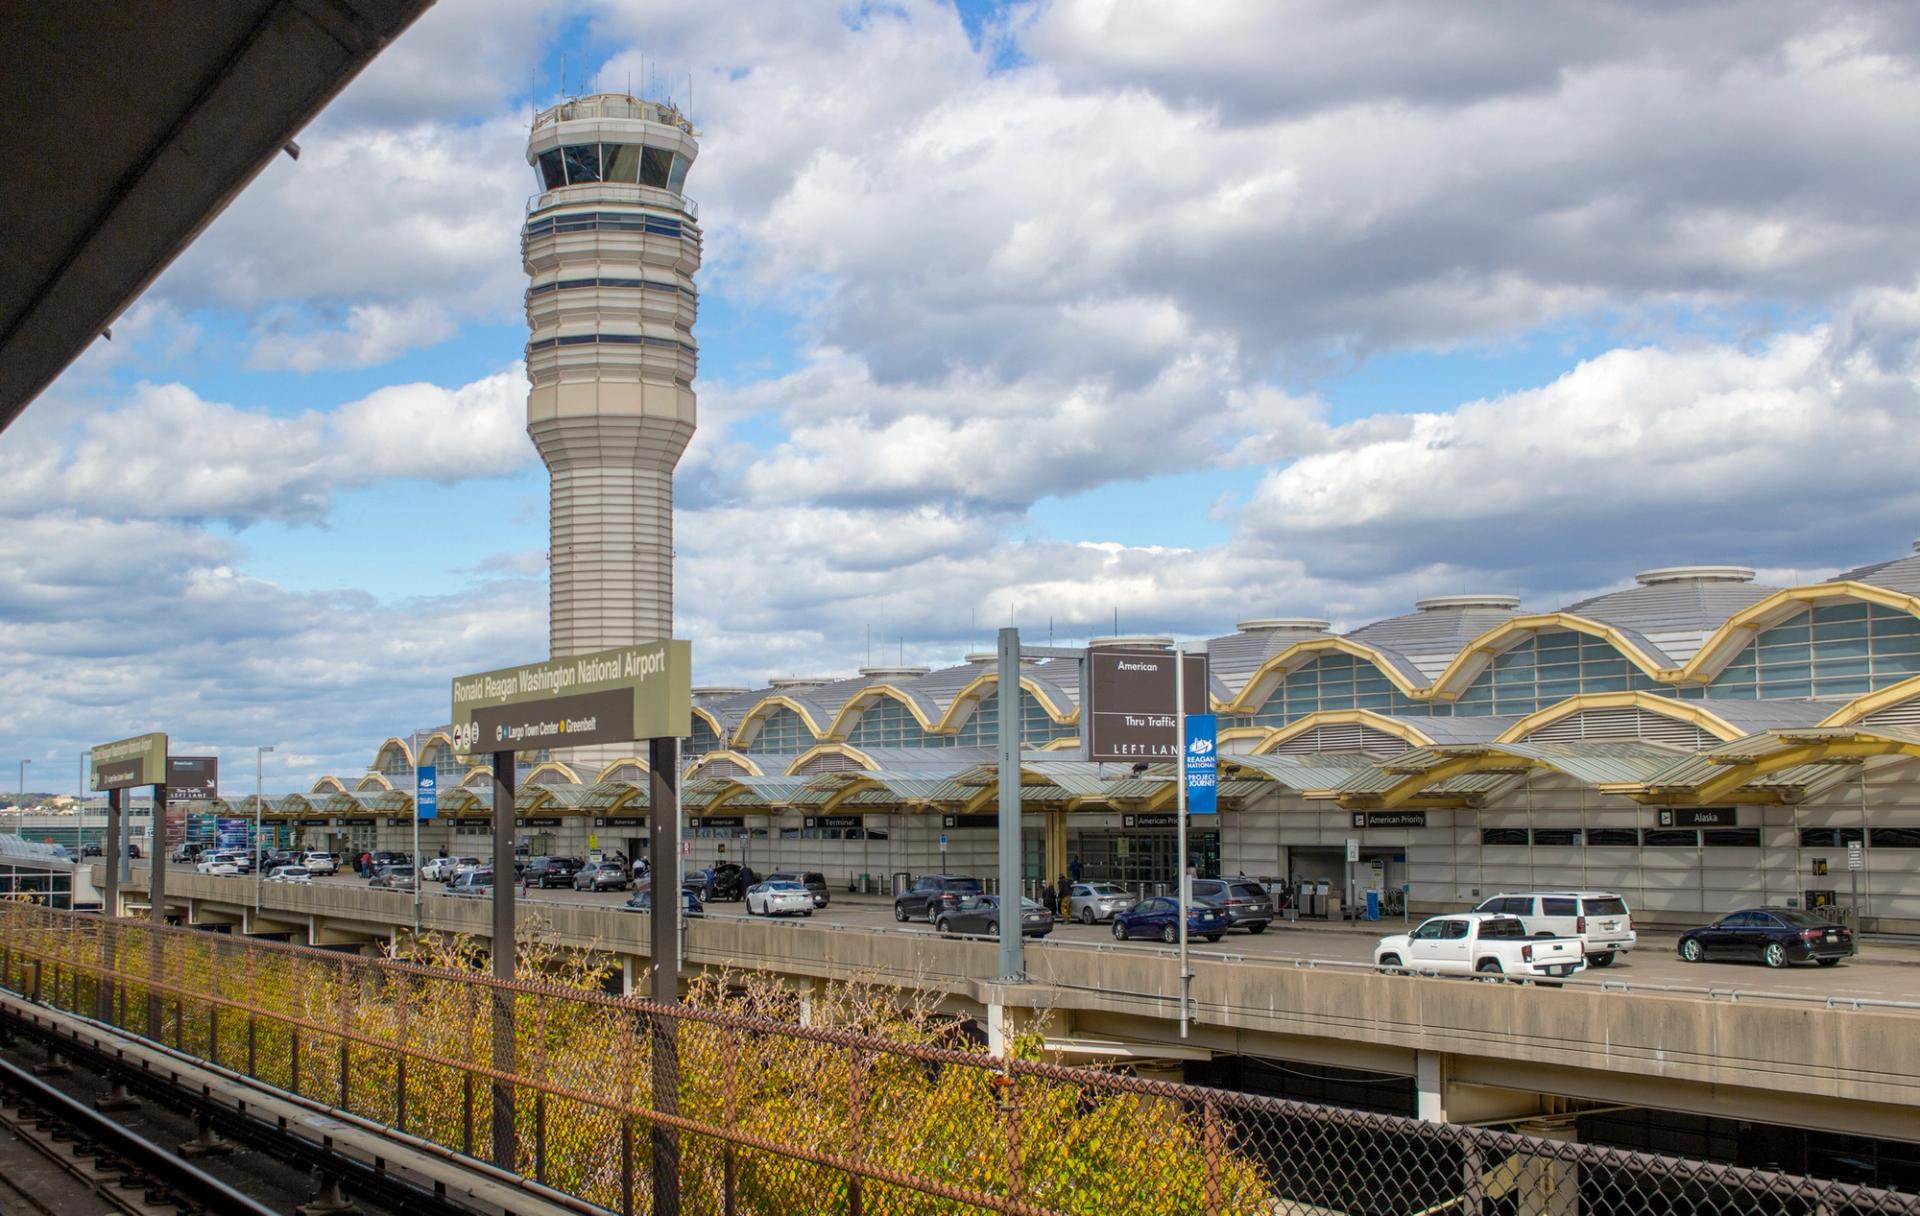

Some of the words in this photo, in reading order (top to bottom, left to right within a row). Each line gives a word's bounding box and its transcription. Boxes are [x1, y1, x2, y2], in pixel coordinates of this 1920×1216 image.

[1118, 661, 1158, 671] American
[454, 677, 483, 703] Ronald
[485, 676, 518, 702] Reagan
[519, 665, 575, 694] Washington
[578, 654, 621, 684] National
[624, 648, 665, 681] Airport
[1125, 716, 1145, 726] Thru
[1148, 716, 1175, 727] Traffic
[508, 725, 524, 741] Largo
[524, 724, 539, 737] Town
[540, 721, 559, 735] Center
[566, 717, 596, 733] Greenbelt
[1114, 744, 1145, 754] LEFT
[825, 818, 855, 826] Terminal
[1138, 816, 1167, 825] American
[1370, 815, 1400, 825] American
[1401, 815, 1424, 826] Priority
[1694, 812, 1719, 823] Alaska
